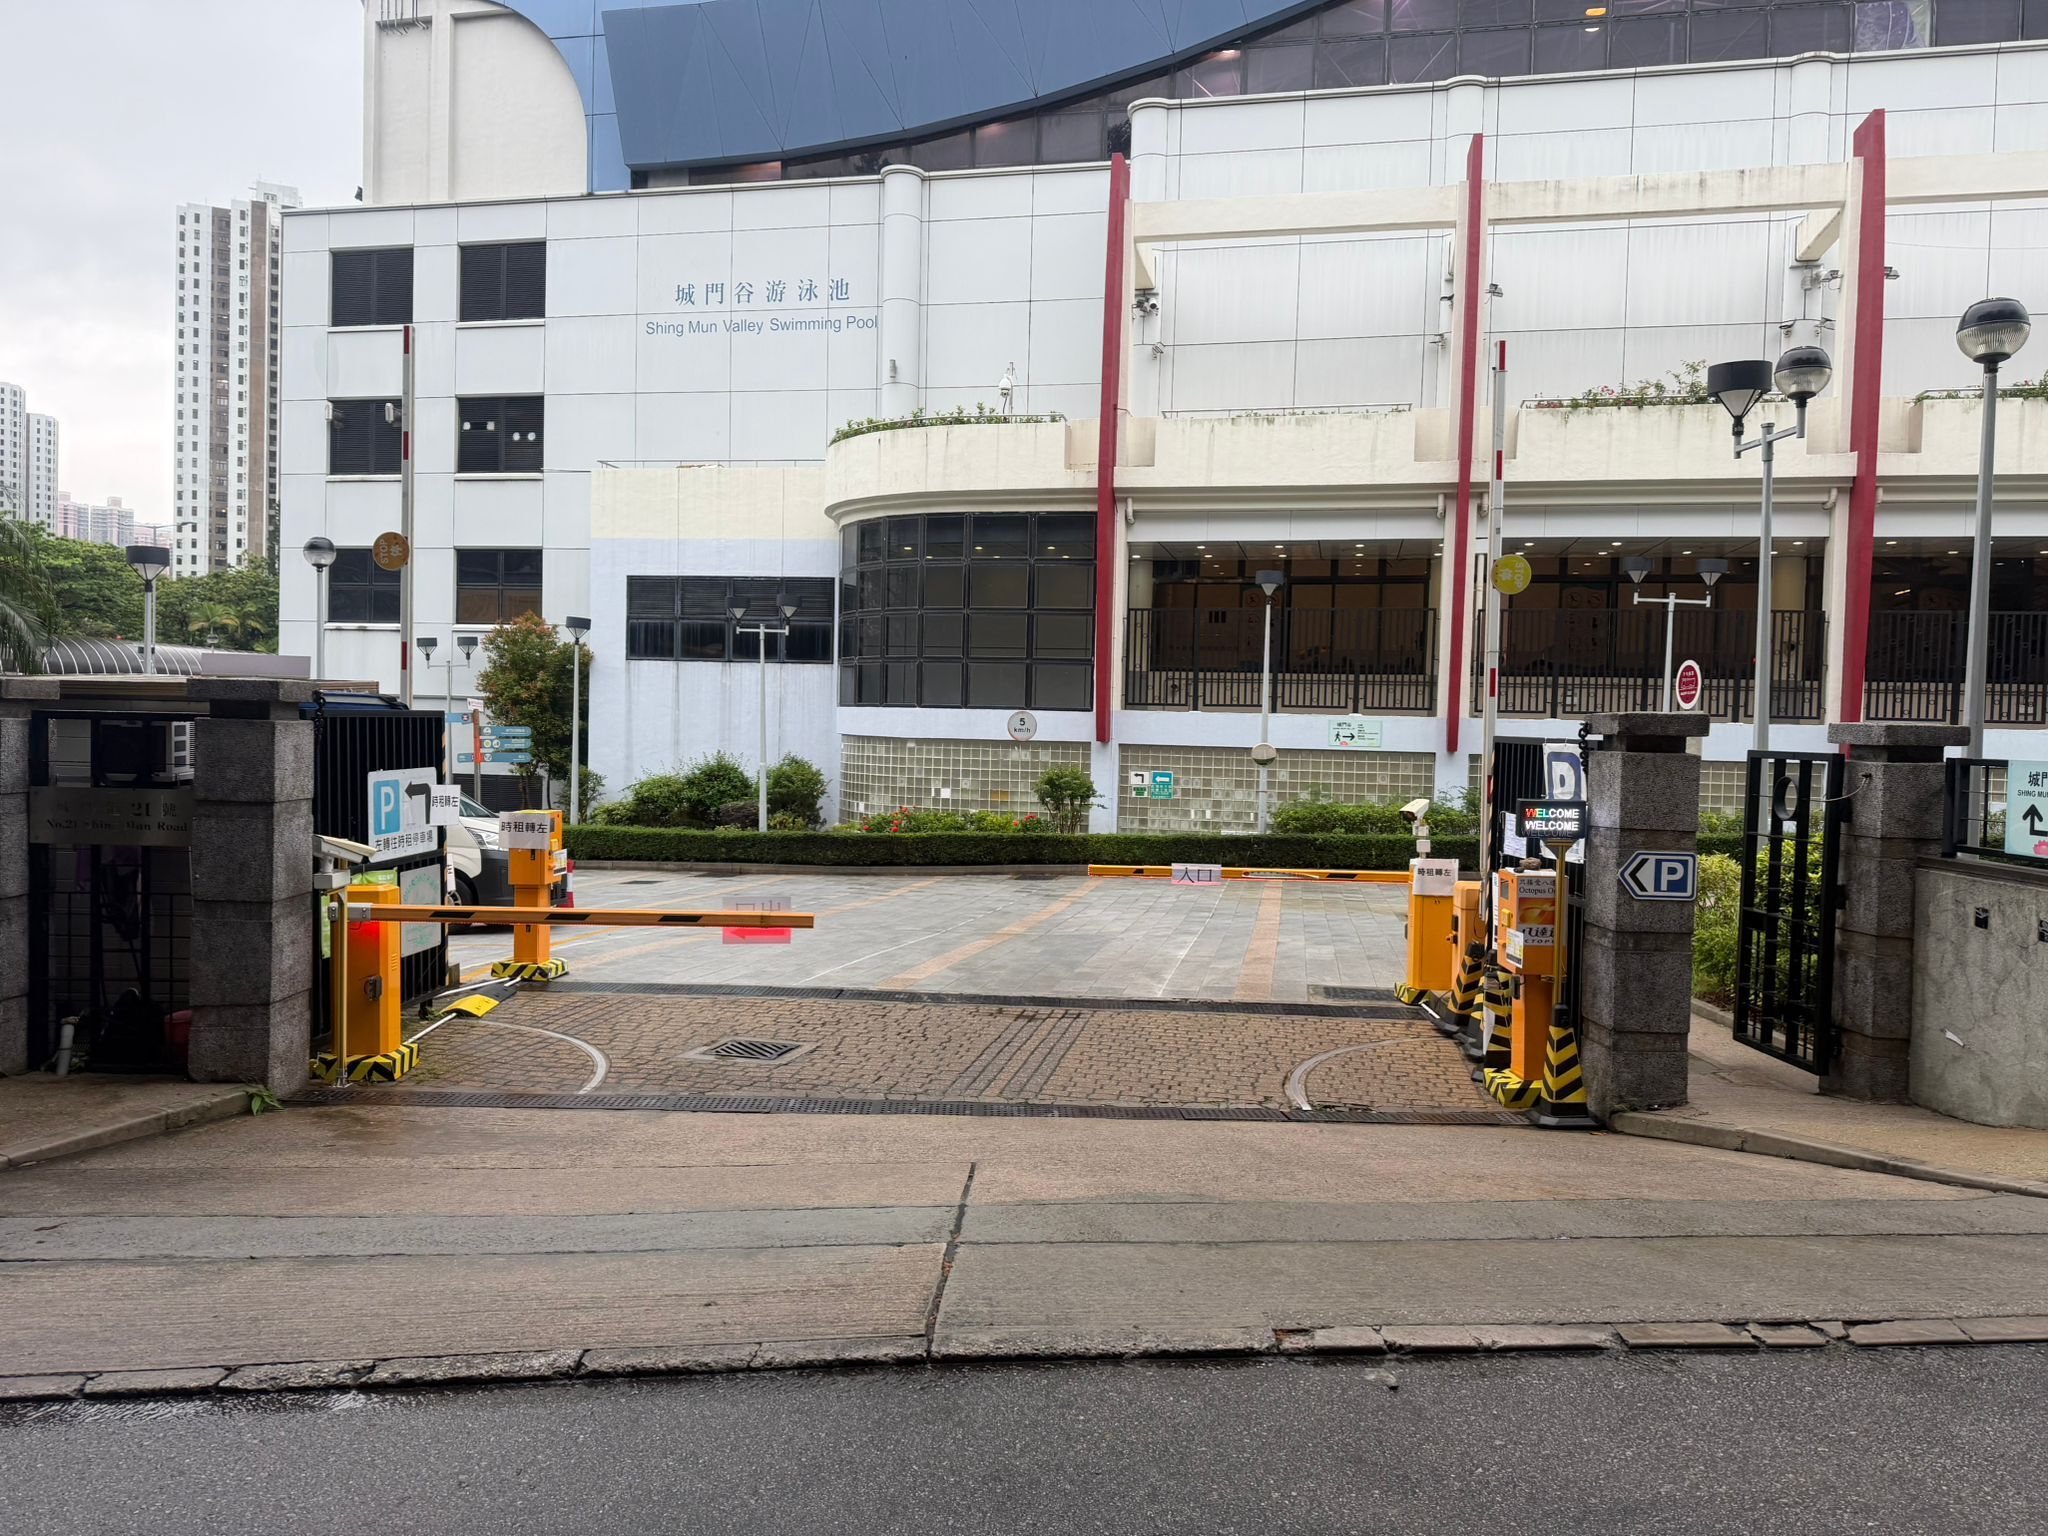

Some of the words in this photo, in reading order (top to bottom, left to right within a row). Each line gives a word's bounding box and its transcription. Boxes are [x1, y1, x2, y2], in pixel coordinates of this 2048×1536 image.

[675, 278, 850, 306] 城門谷游泳池
[646, 320, 684, 337] Shing
[688, 320, 718, 334] Mun
[722, 319, 764, 335] Valley
[769, 316, 841, 333] Swimming
[846, 315, 878, 329] Pool
[1019, 717, 1026, 726] 5
[2017, 790, 2036, 798] SHING
[381, 786, 395, 831] P
[1525, 808, 1580, 819] WELCOME
[157, 822, 188, 831] Road
[501, 821, 548, 834] 時租轉左
[1524, 821, 1580, 831] WELCOME
[1417, 868, 1452, 877] 時租轉左
[1660, 861, 1684, 891] P
[1519, 887, 1546, 895] Octopus
